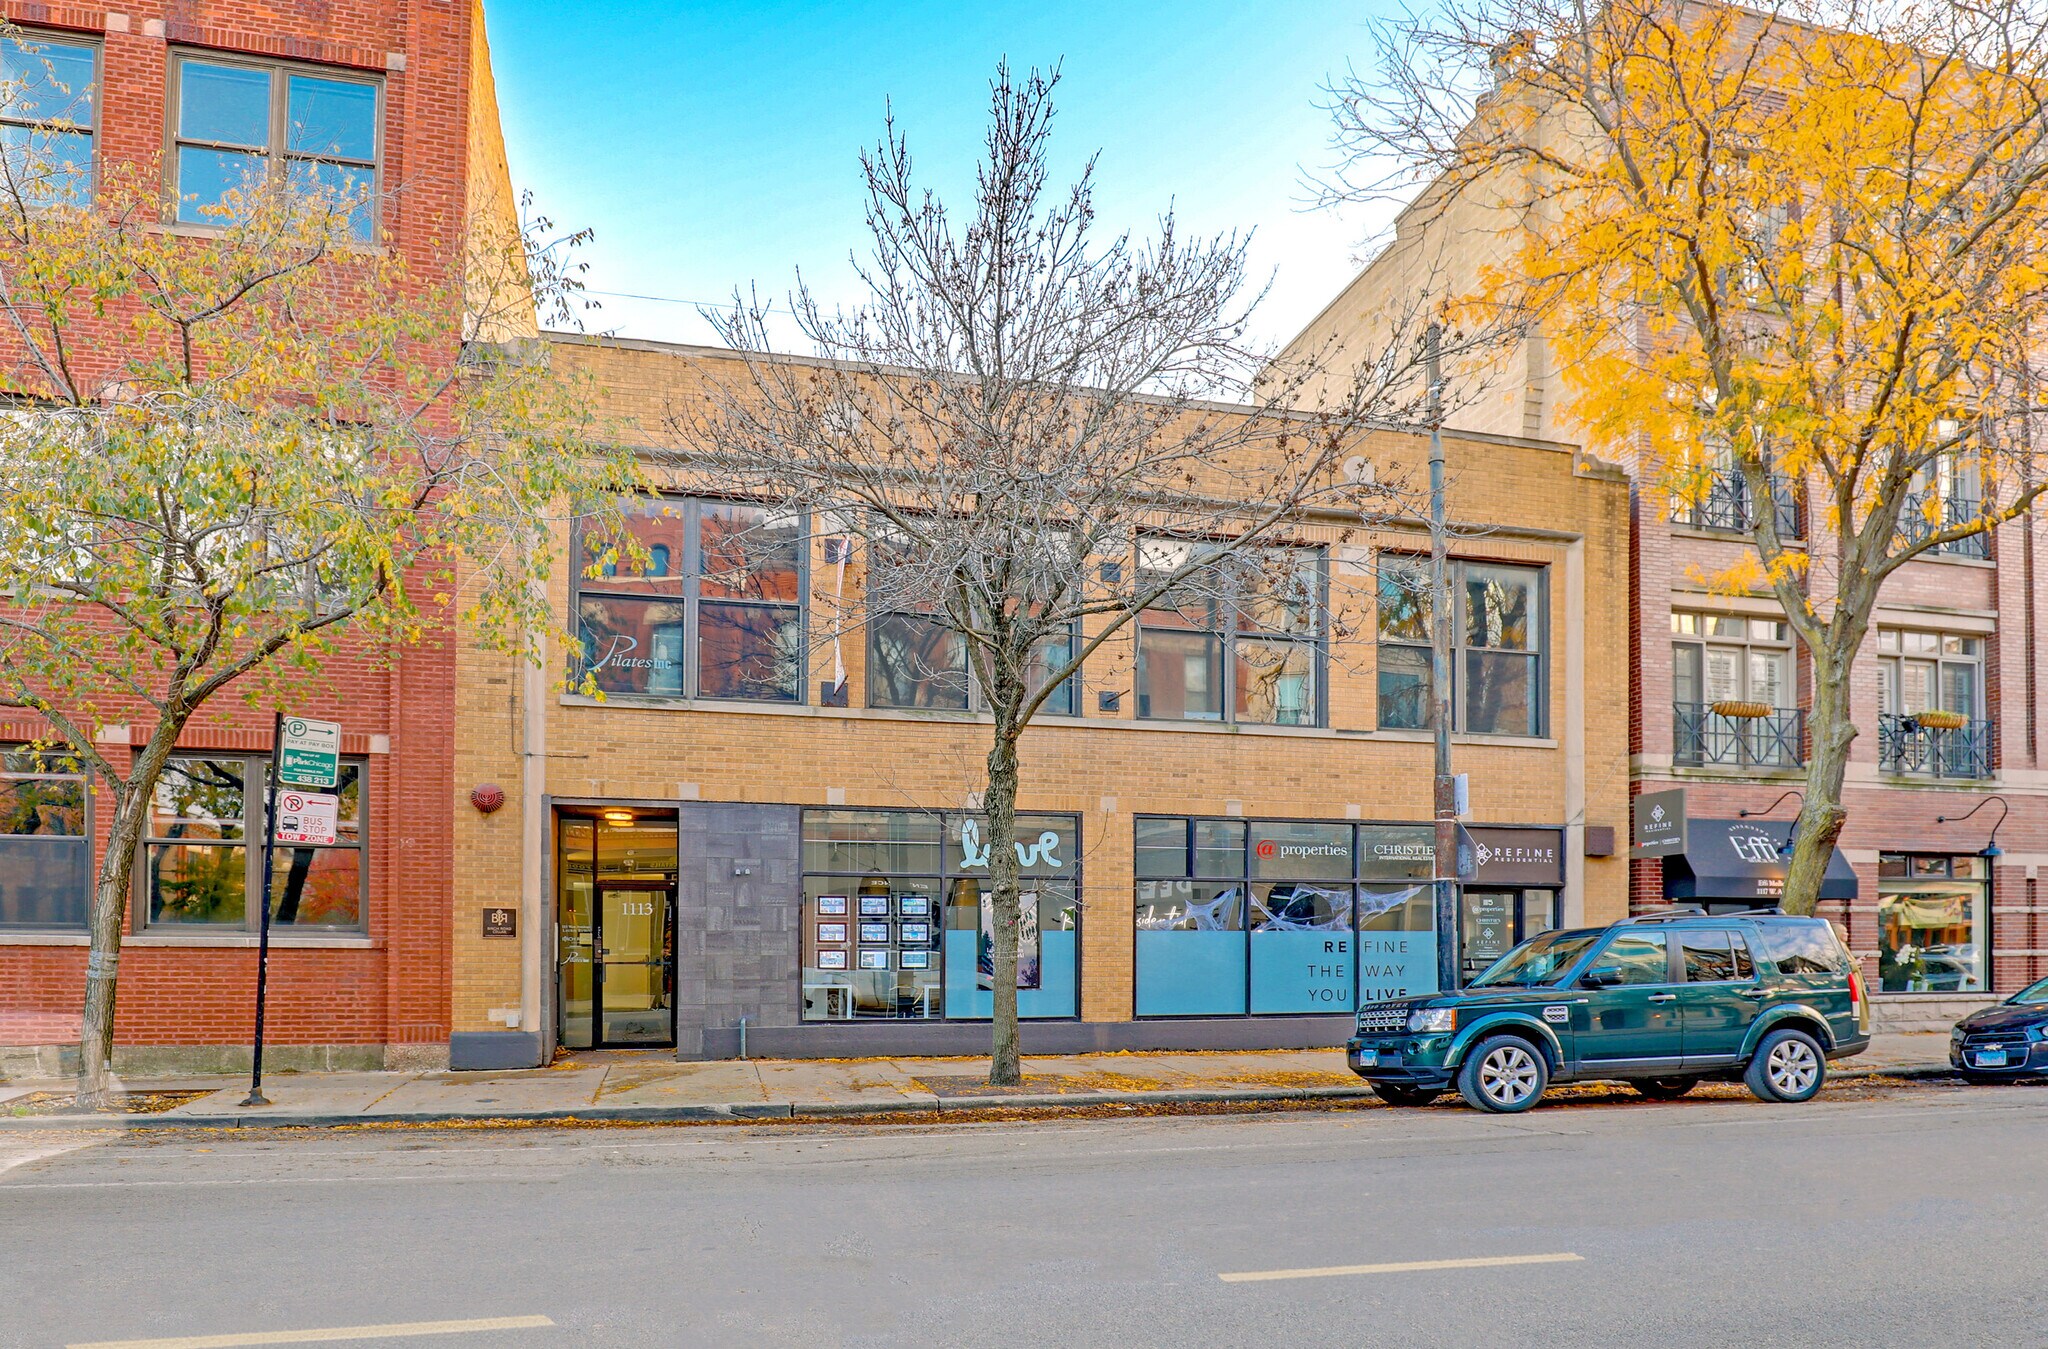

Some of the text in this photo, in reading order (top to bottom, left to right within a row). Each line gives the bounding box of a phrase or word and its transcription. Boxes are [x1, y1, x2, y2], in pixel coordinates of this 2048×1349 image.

[587, 633, 672, 671] Pilates inc
[293, 757, 334, 770] ParkChicago
[297, 775, 312, 783] 438
[314, 776, 329, 785] 213
[303, 816, 323, 826] BUS
[1644, 821, 1672, 830] REFINE
[303, 825, 327, 834] STOP
[281, 832, 329, 844] TOW ZONE
[960, 819, 1062, 869] lve
[1374, 844, 1436, 855] CHRISTIE'
[1494, 847, 1553, 858] REFINE
[1729, 836, 1780, 860] Effi
[622, 902, 654, 916] 1113
[1324, 941, 1408, 953] RE FINE
[1307, 964, 1405, 977] THE WAY
[1308, 988, 1407, 1002] YOU LIVE
